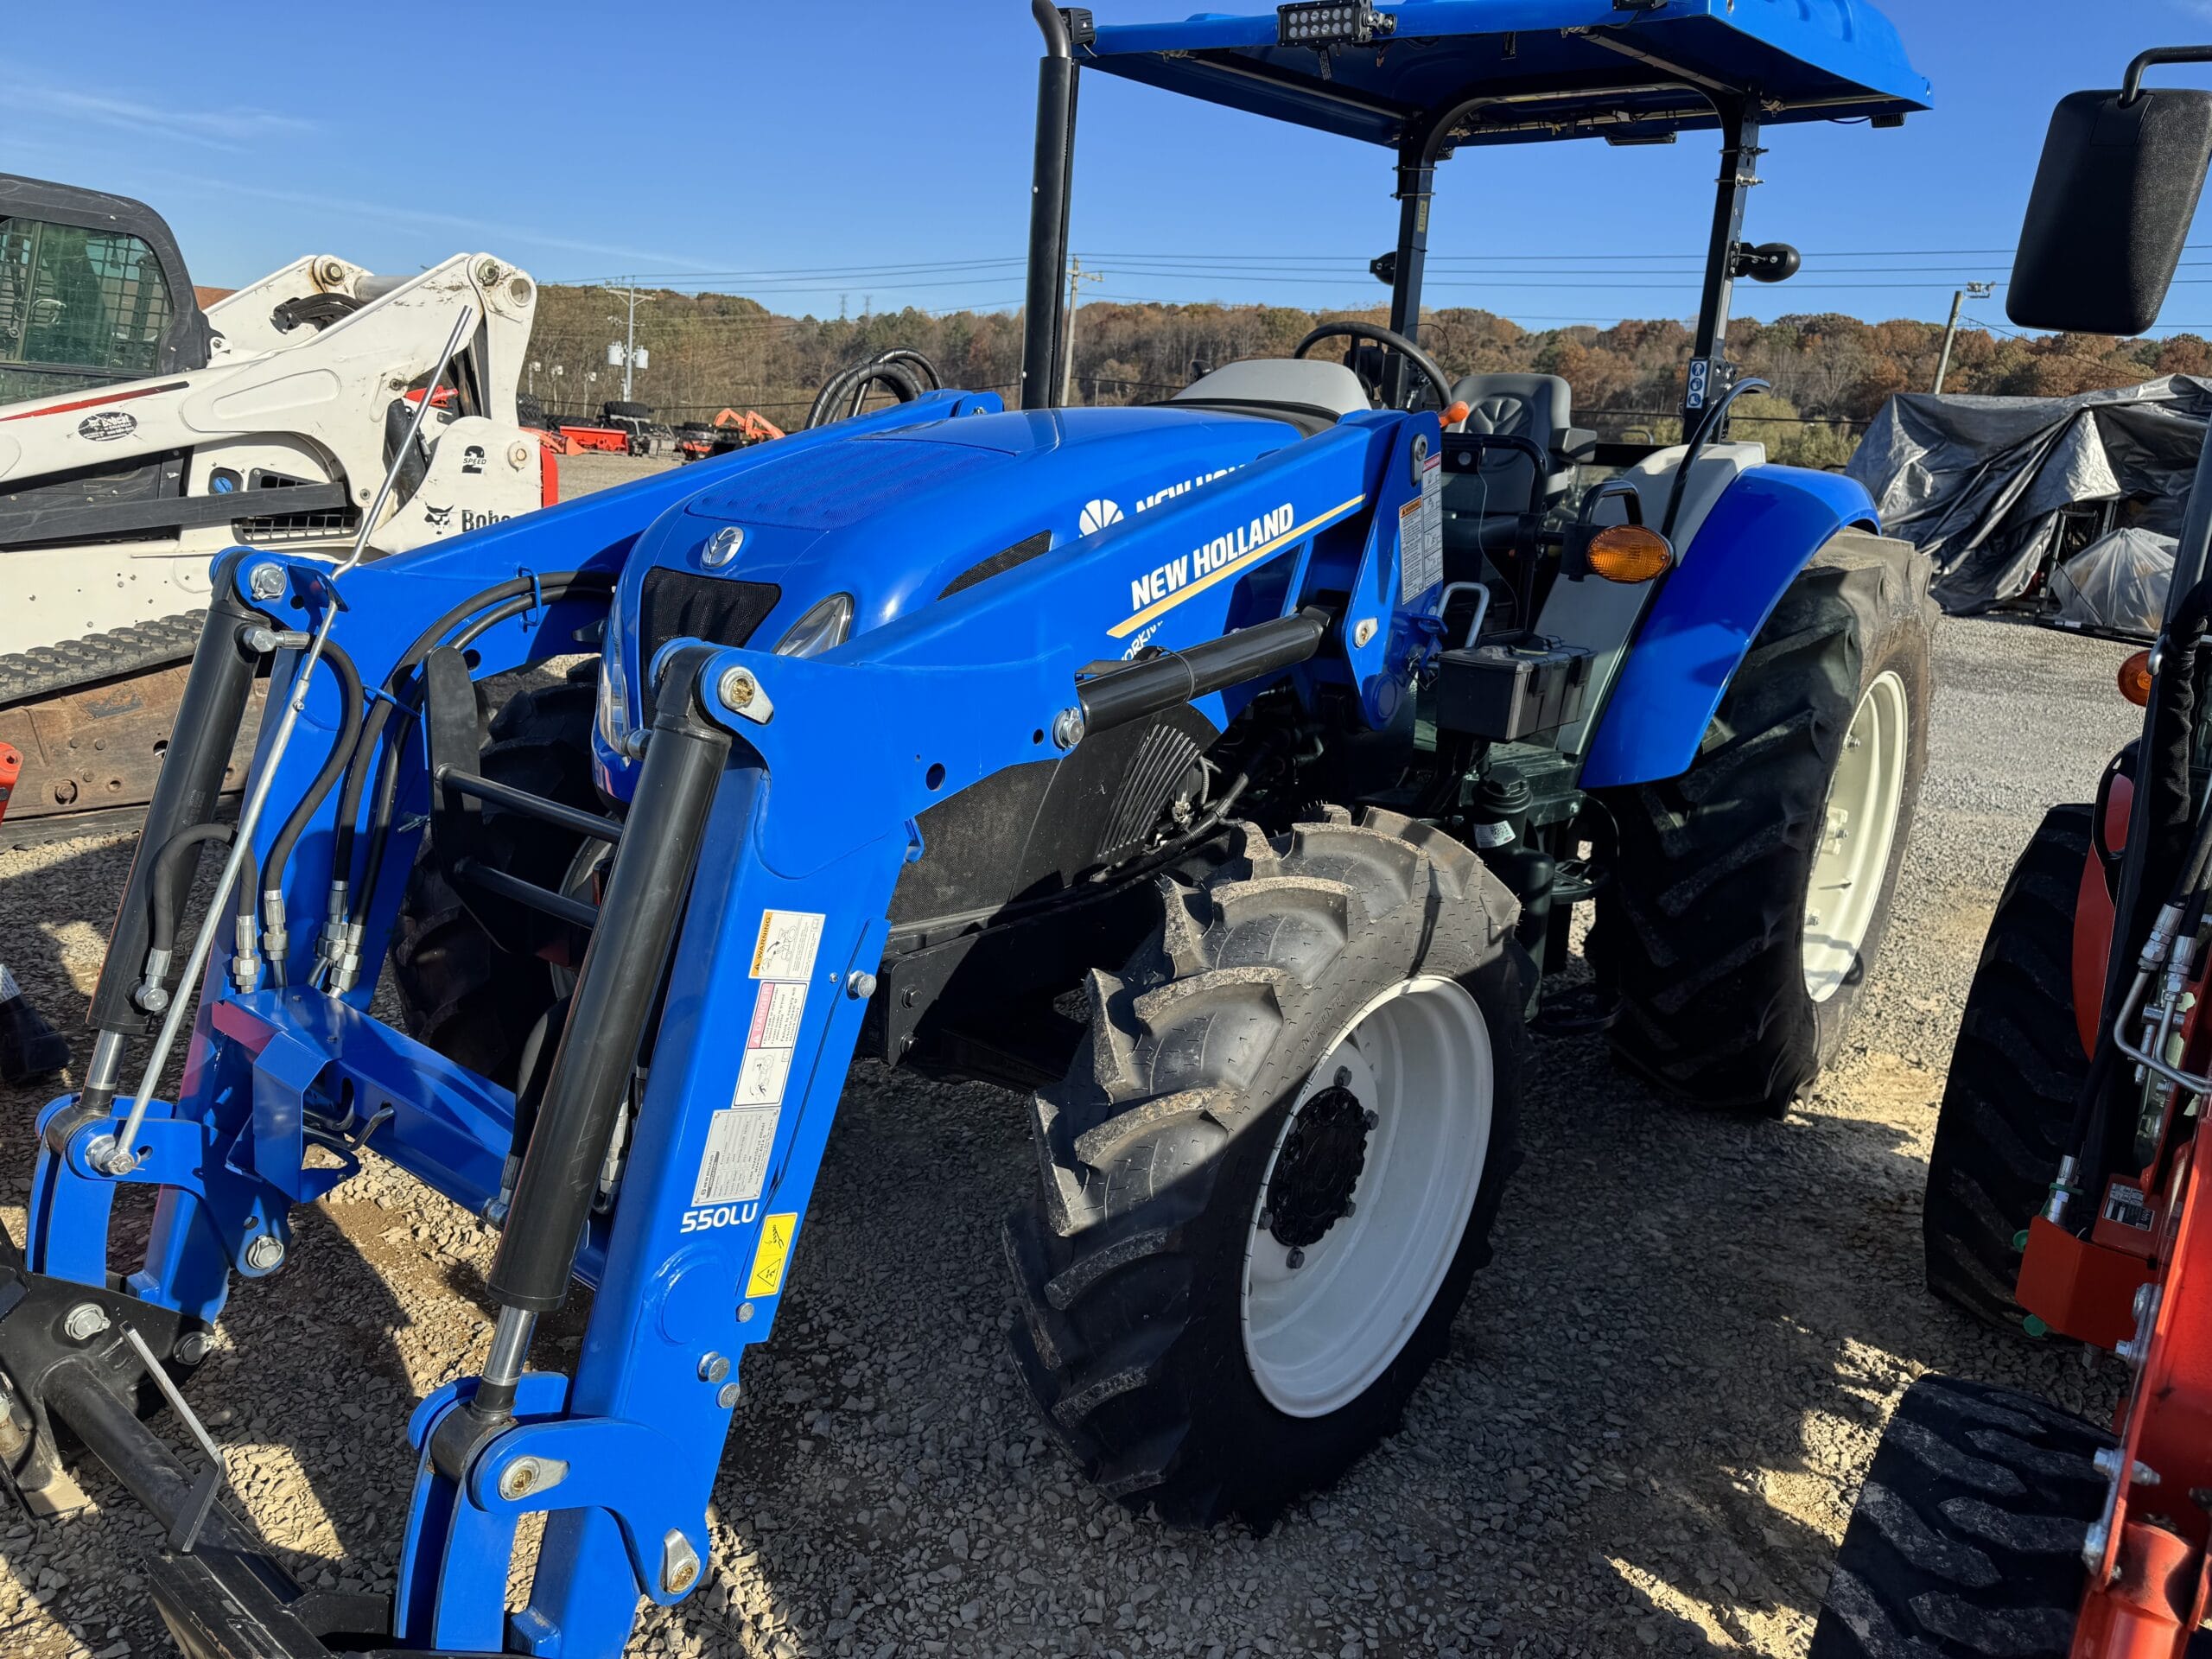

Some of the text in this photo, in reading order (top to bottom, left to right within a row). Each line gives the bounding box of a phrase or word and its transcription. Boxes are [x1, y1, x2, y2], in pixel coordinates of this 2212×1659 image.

[461, 445, 485, 474] 2
[461, 509, 512, 533] Bob
[1131, 502, 1294, 611] NEW HOLLAND
[758, 917, 771, 959] WARNING
[680, 1203, 758, 1233] 550LU
